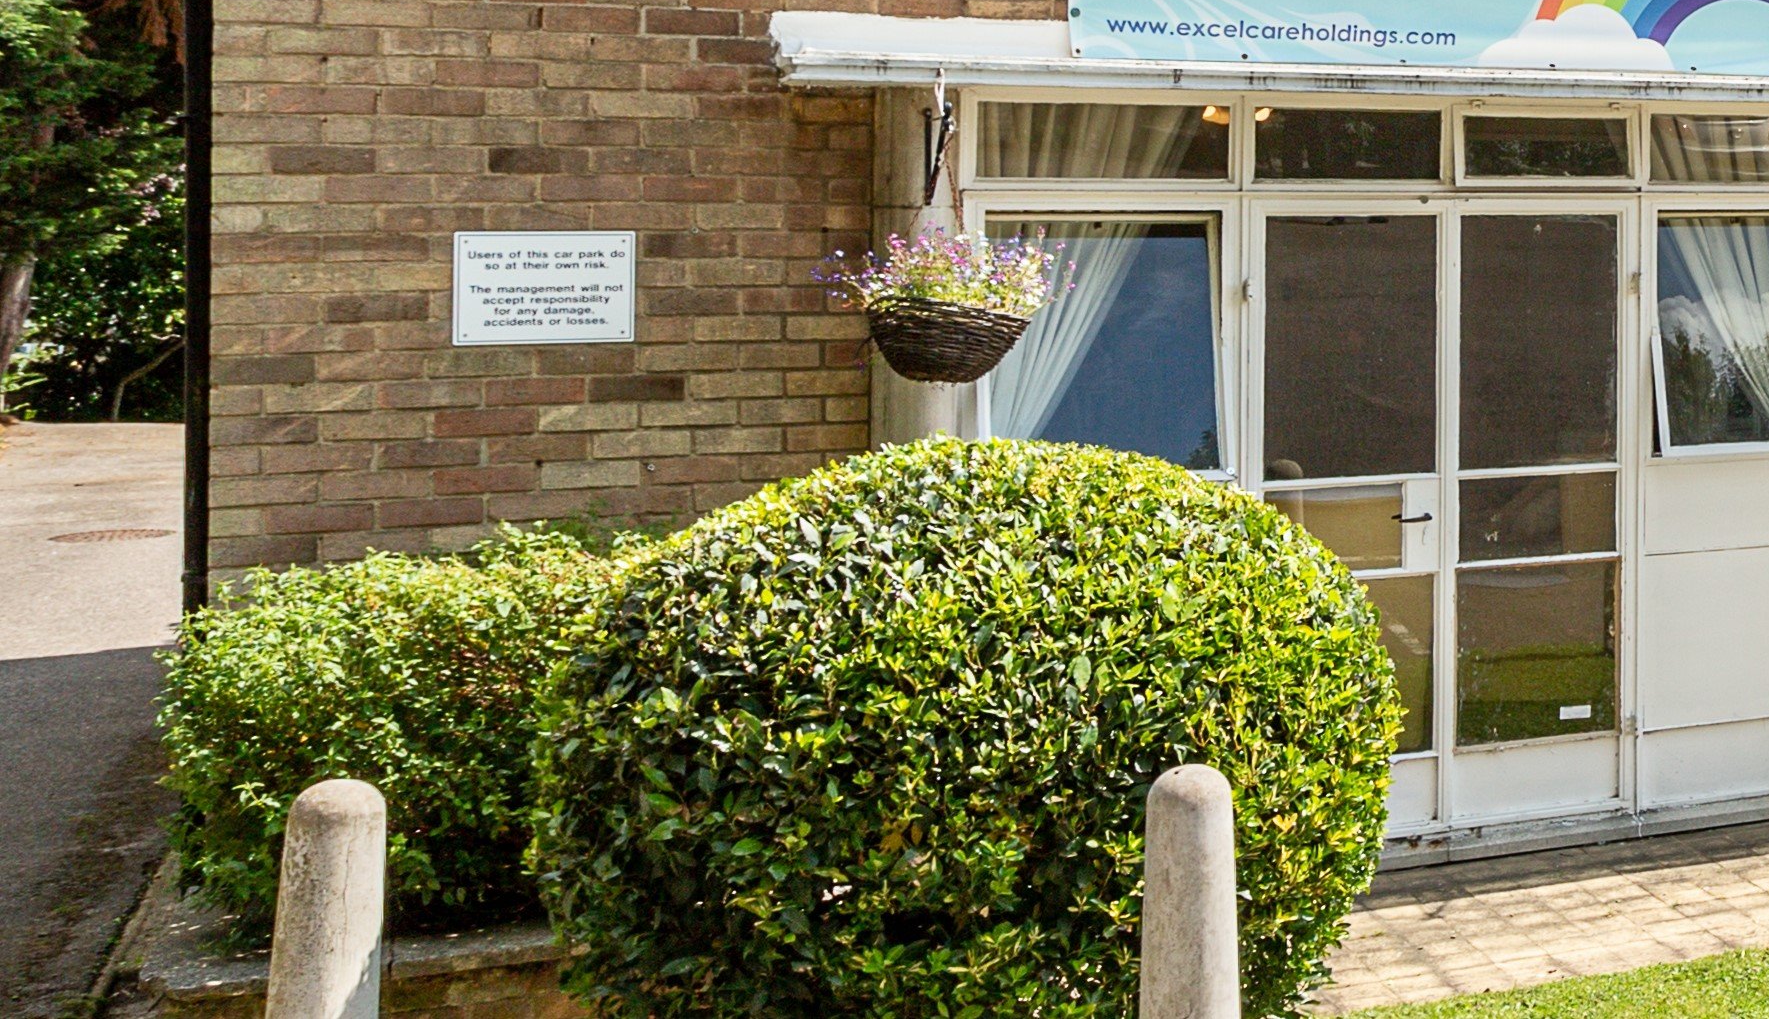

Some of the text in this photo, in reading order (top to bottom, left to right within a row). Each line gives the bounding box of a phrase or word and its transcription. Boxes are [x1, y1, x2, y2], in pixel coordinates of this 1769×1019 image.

[1106, 18, 1456, 47] www.excelcareholdings.com
[468, 251, 503, 259] Users
[509, 250, 521, 259] of
[527, 250, 548, 258] this
[579, 250, 605, 259] park
[610, 250, 625, 258] do
[584, 261, 609, 269] risk.
[469, 284, 623, 294] The management will not
[483, 295, 610, 305] accept responsibility
[494, 307, 511, 315] for
[517, 308, 538, 316] any
[484, 317, 609, 327] accidents or losses.
